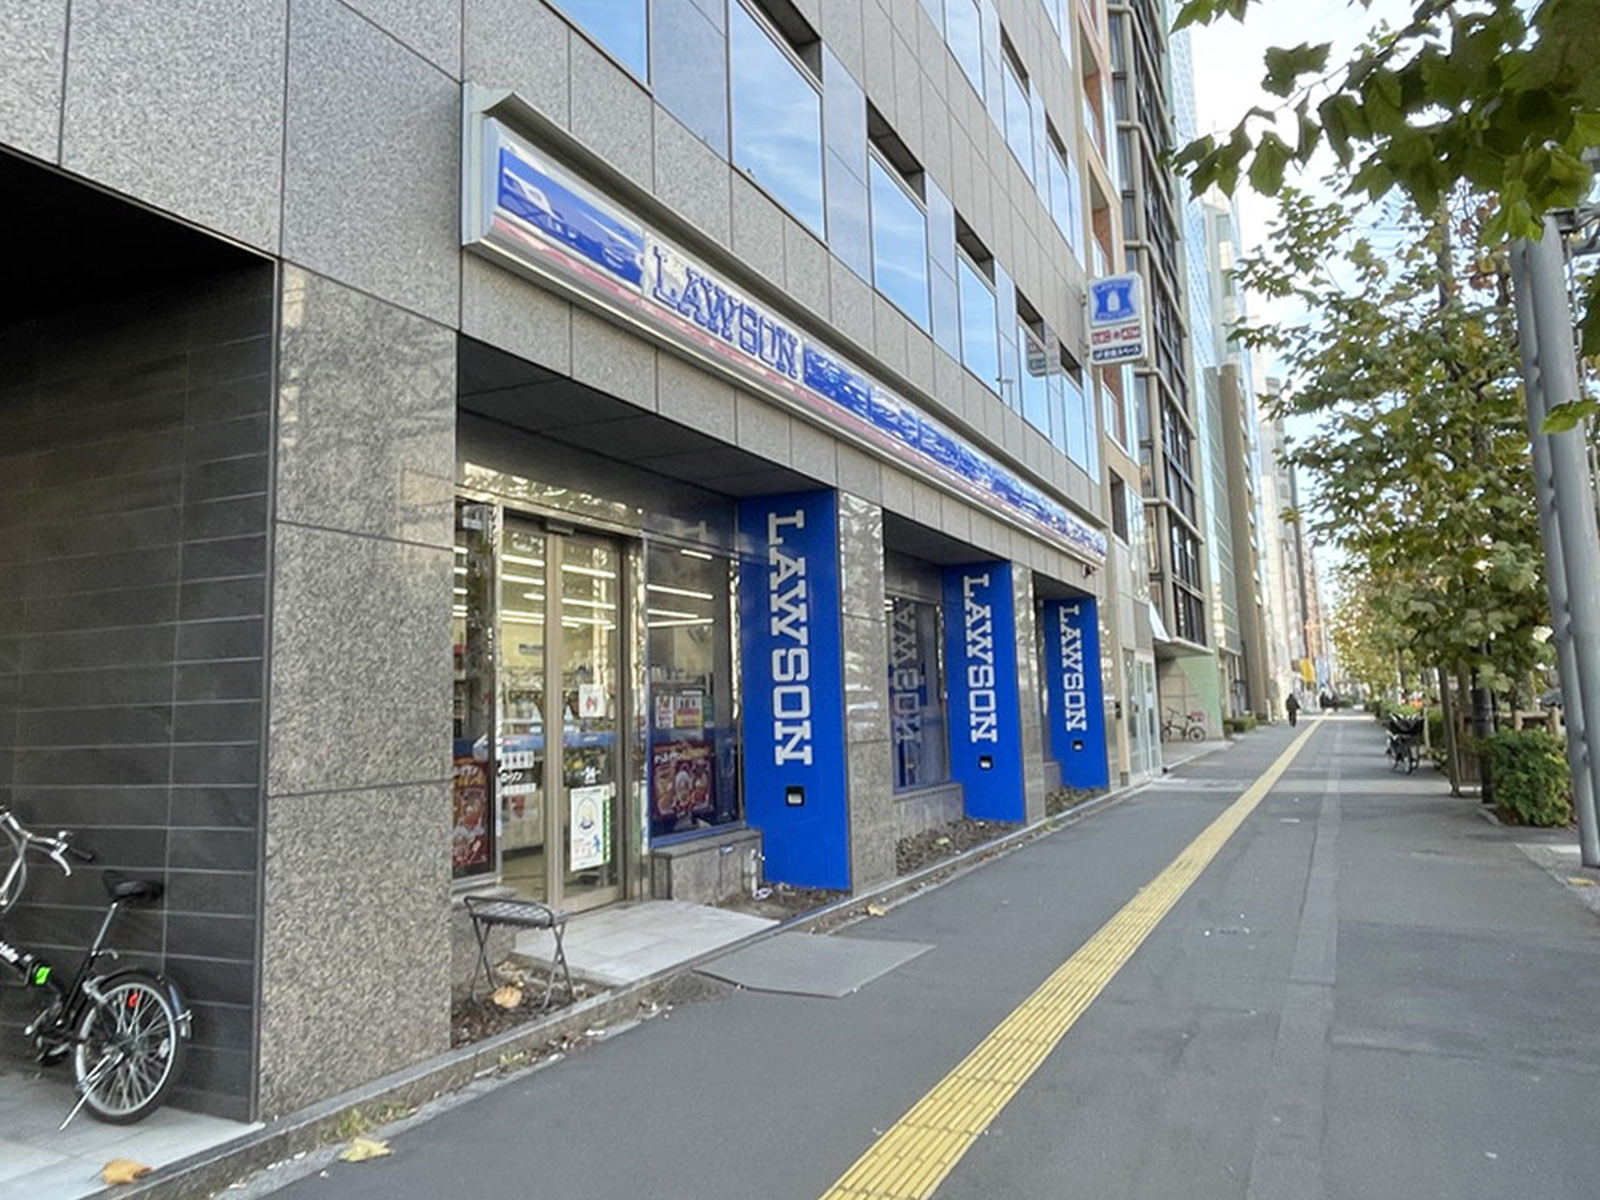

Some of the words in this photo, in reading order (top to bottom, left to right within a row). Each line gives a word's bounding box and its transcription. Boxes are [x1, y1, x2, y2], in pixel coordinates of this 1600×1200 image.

[652, 245, 799, 380] LAWSON
[767, 509, 813, 766] LAWSON
[963, 573, 998, 744] LAWSON
[1058, 604, 1088, 732] LAWSON
